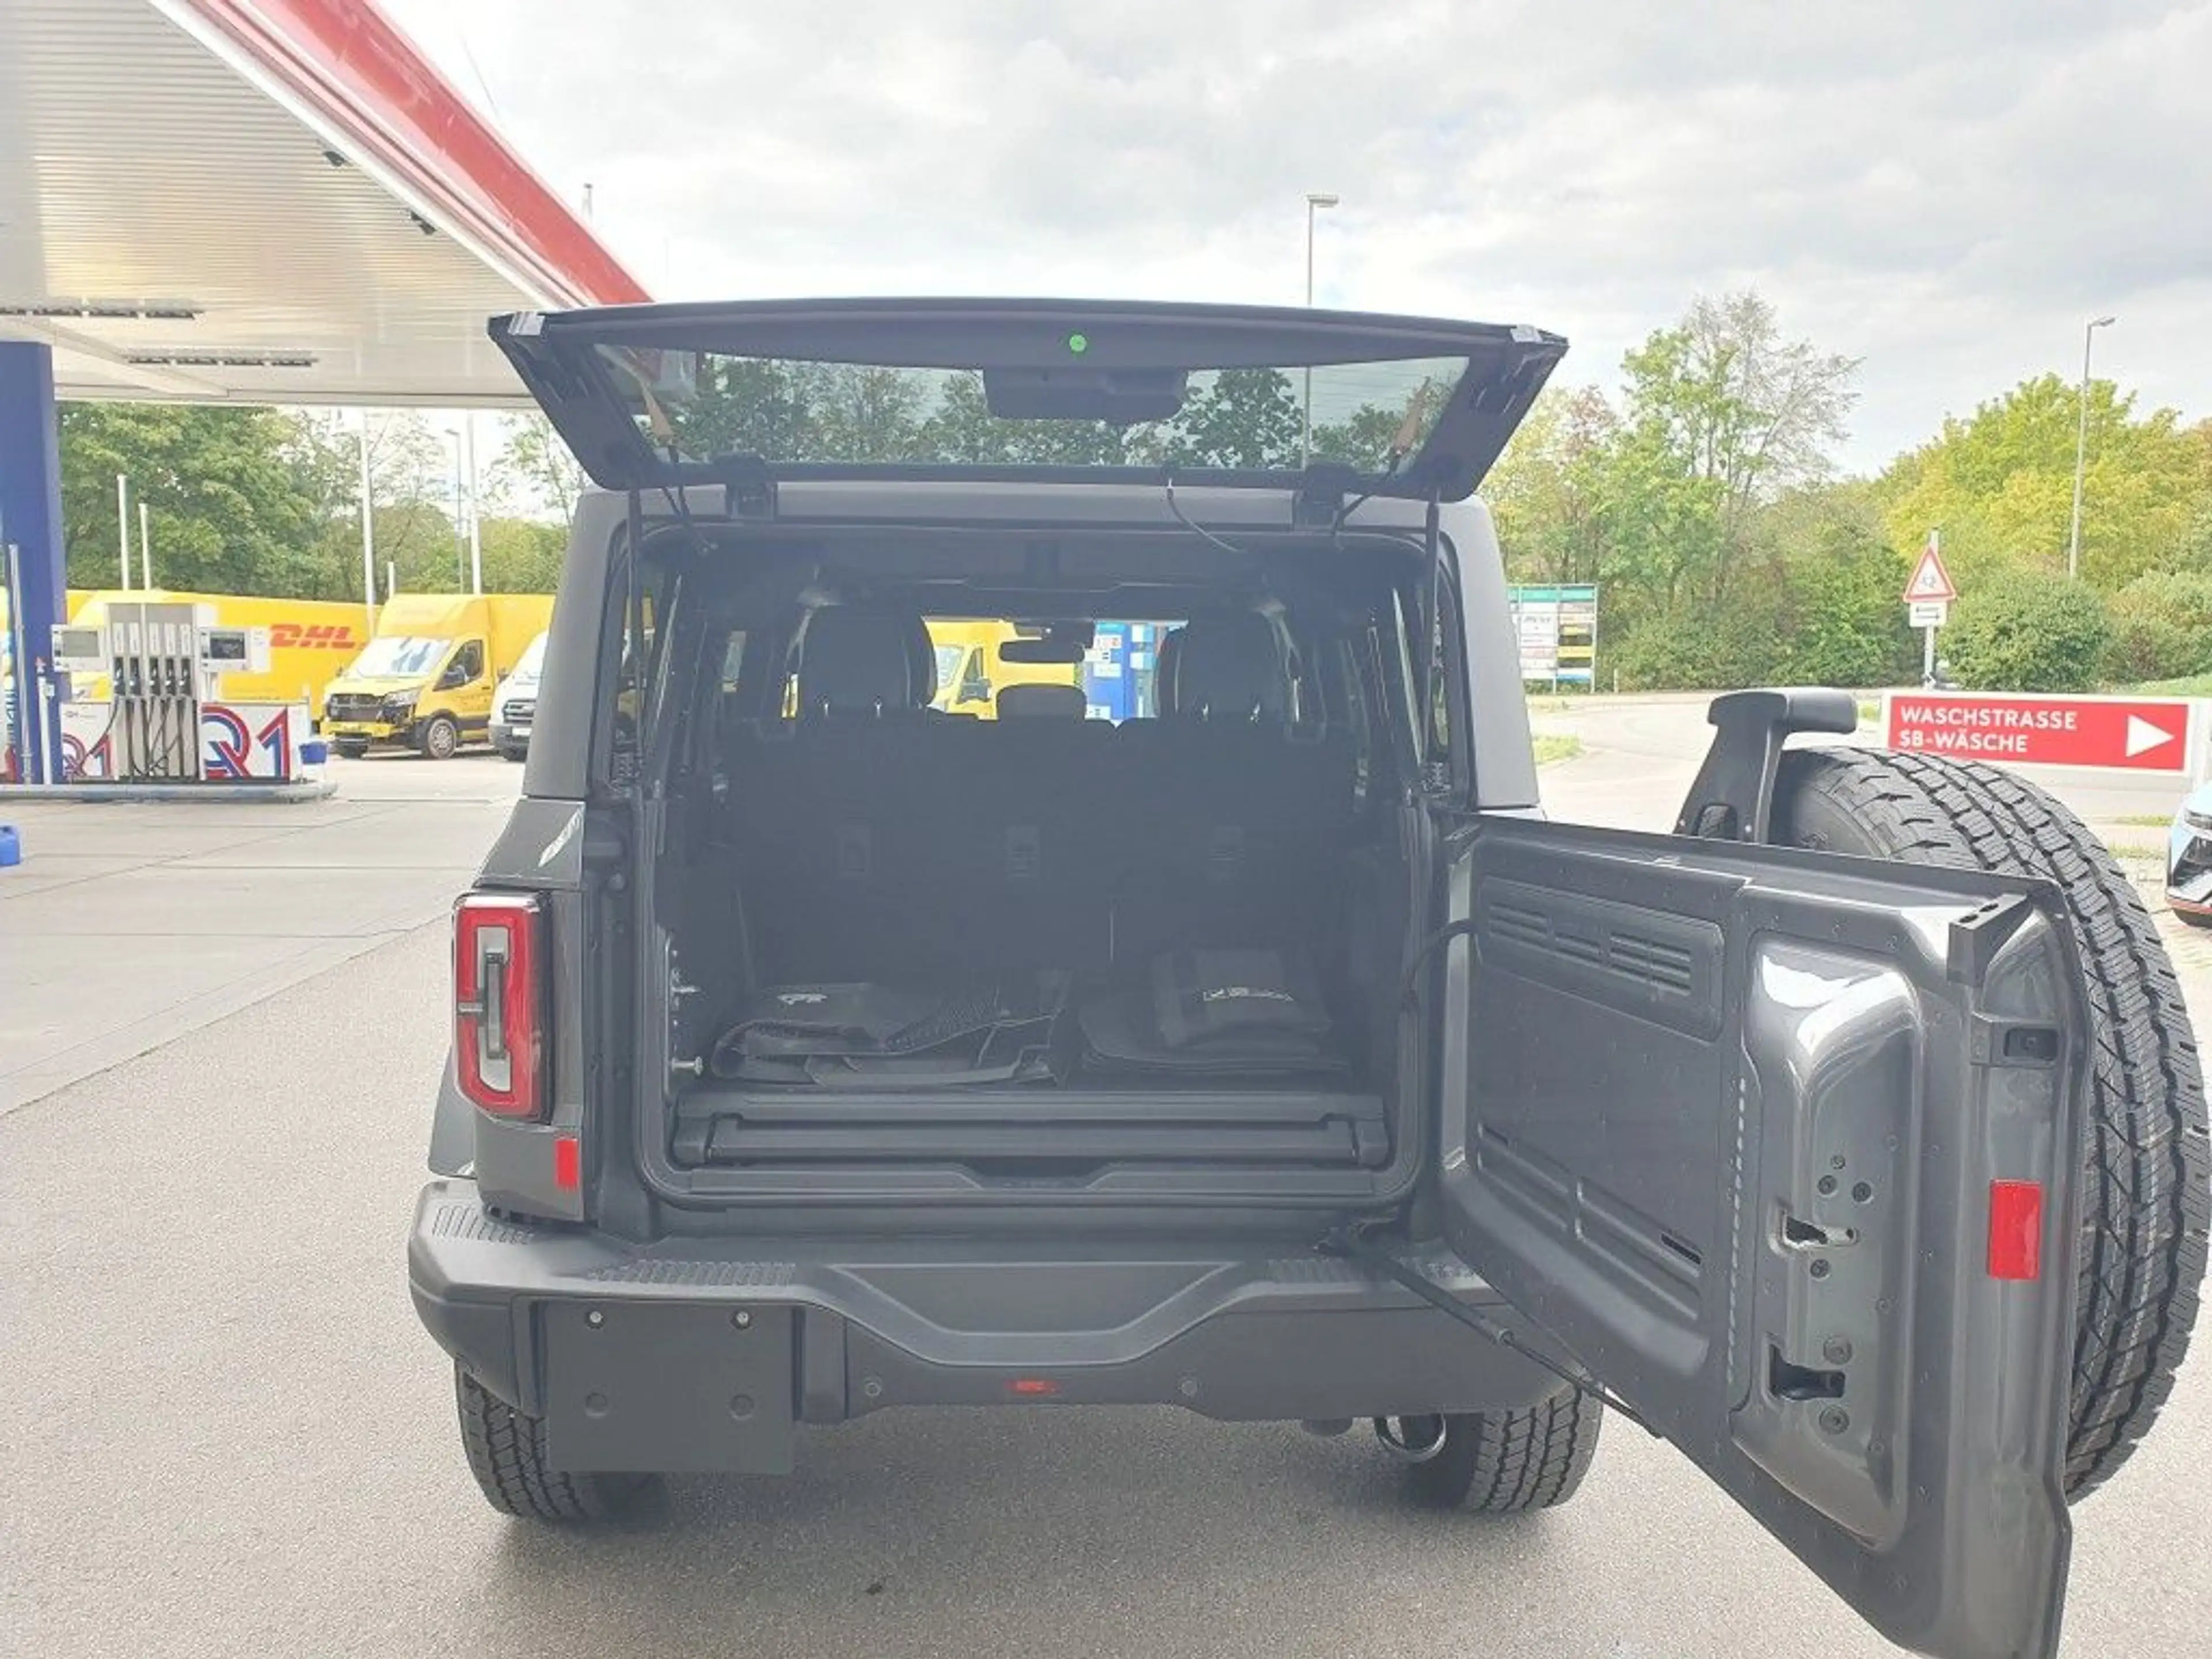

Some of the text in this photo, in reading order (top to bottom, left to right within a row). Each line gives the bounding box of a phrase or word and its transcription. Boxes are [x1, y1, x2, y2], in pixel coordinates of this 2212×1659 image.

[270, 624, 355, 649] DHL
[1902, 706, 2077, 729] WASCHSTRASSE
[201, 703, 290, 779] Q1
[1899, 728, 2028, 753] SB-WÄSCHE
